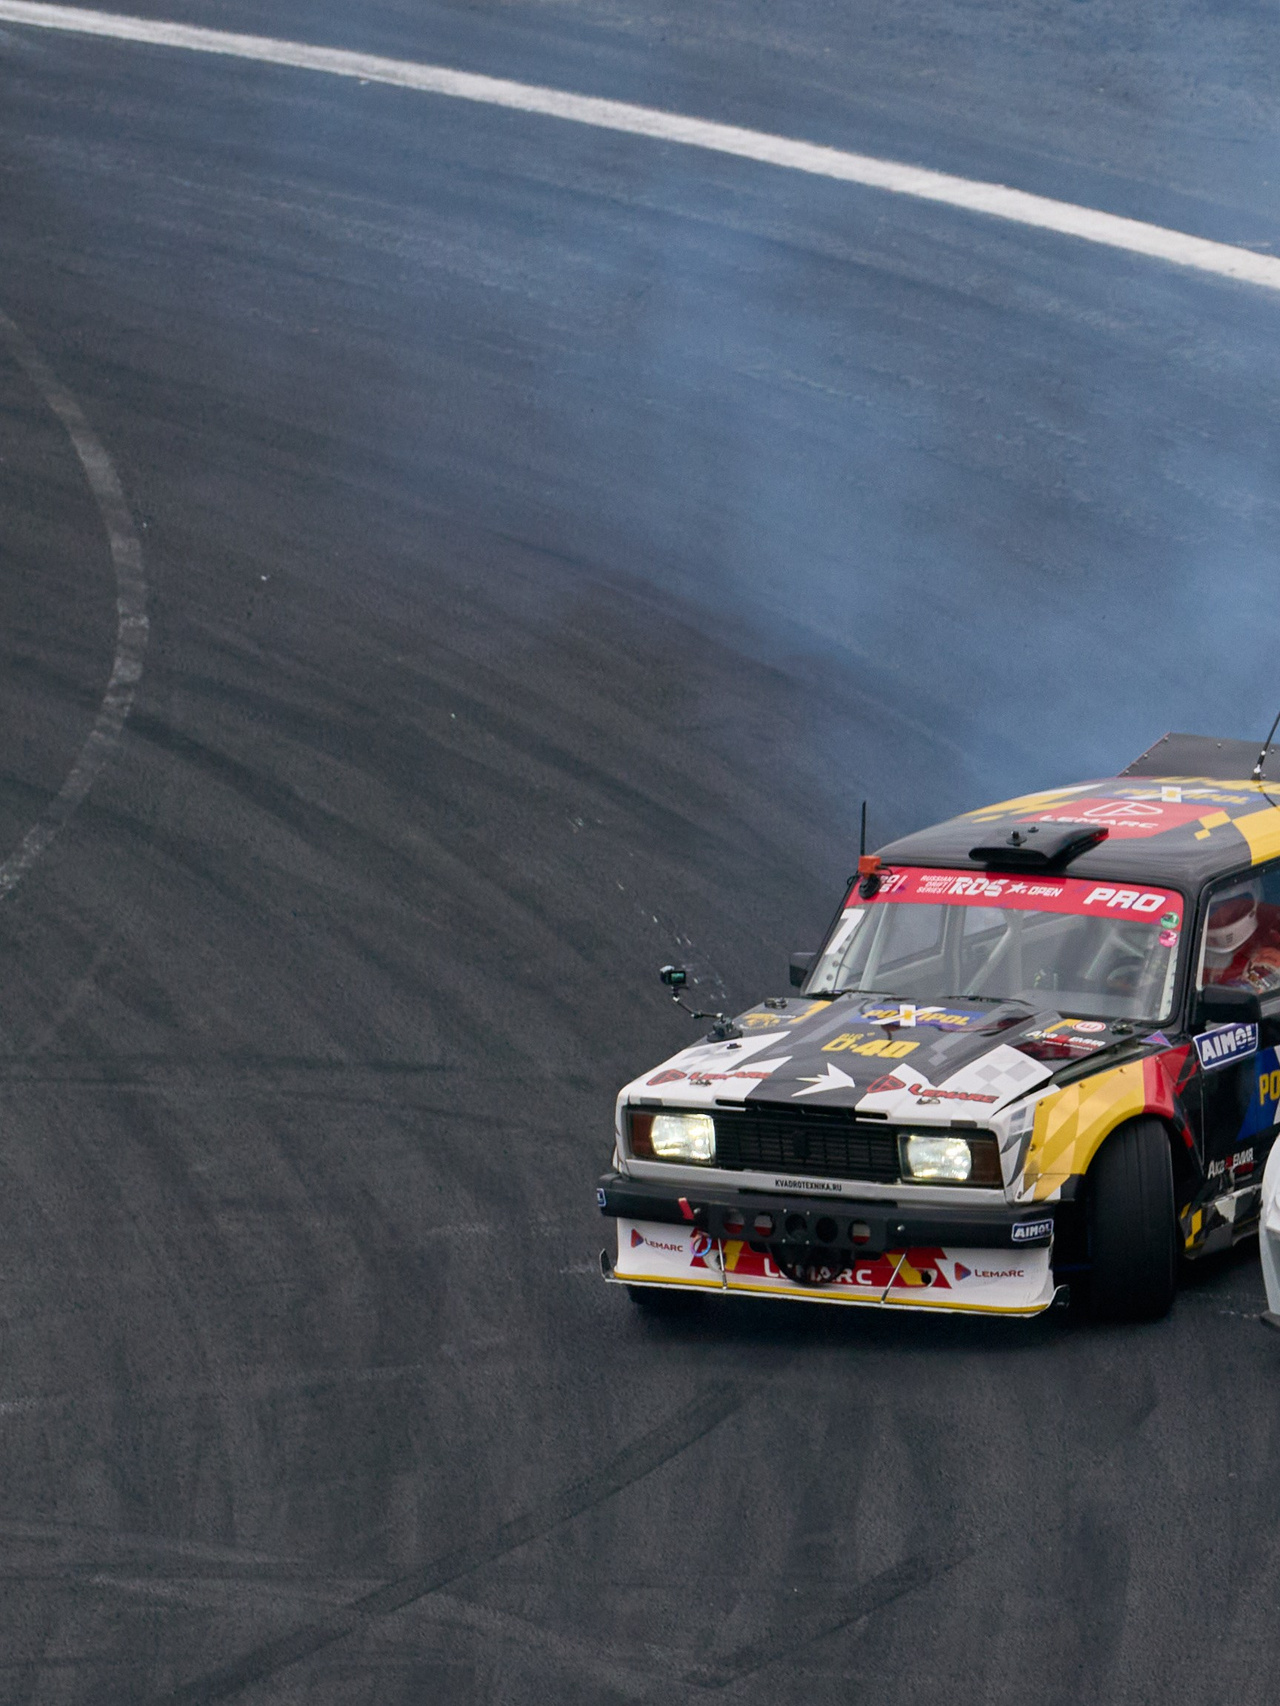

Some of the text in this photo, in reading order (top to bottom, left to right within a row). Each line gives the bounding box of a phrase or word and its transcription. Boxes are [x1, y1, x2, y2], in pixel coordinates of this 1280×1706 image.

[950, 876, 1064, 898] RDS OPEN
[1082, 887, 1167, 912] PRO
[825, 908, 866, 955] 1
[1202, 1024, 1256, 1062] AIMOL
[908, 1083, 1000, 1104] LEMARC
[774, 1178, 843, 1192] KVADROTEXNIKA.RU
[1014, 1223, 1050, 1238] AIMOL
[644, 1238, 684, 1253] LEMARC
[975, 1269, 1025, 1278] LEMARC
